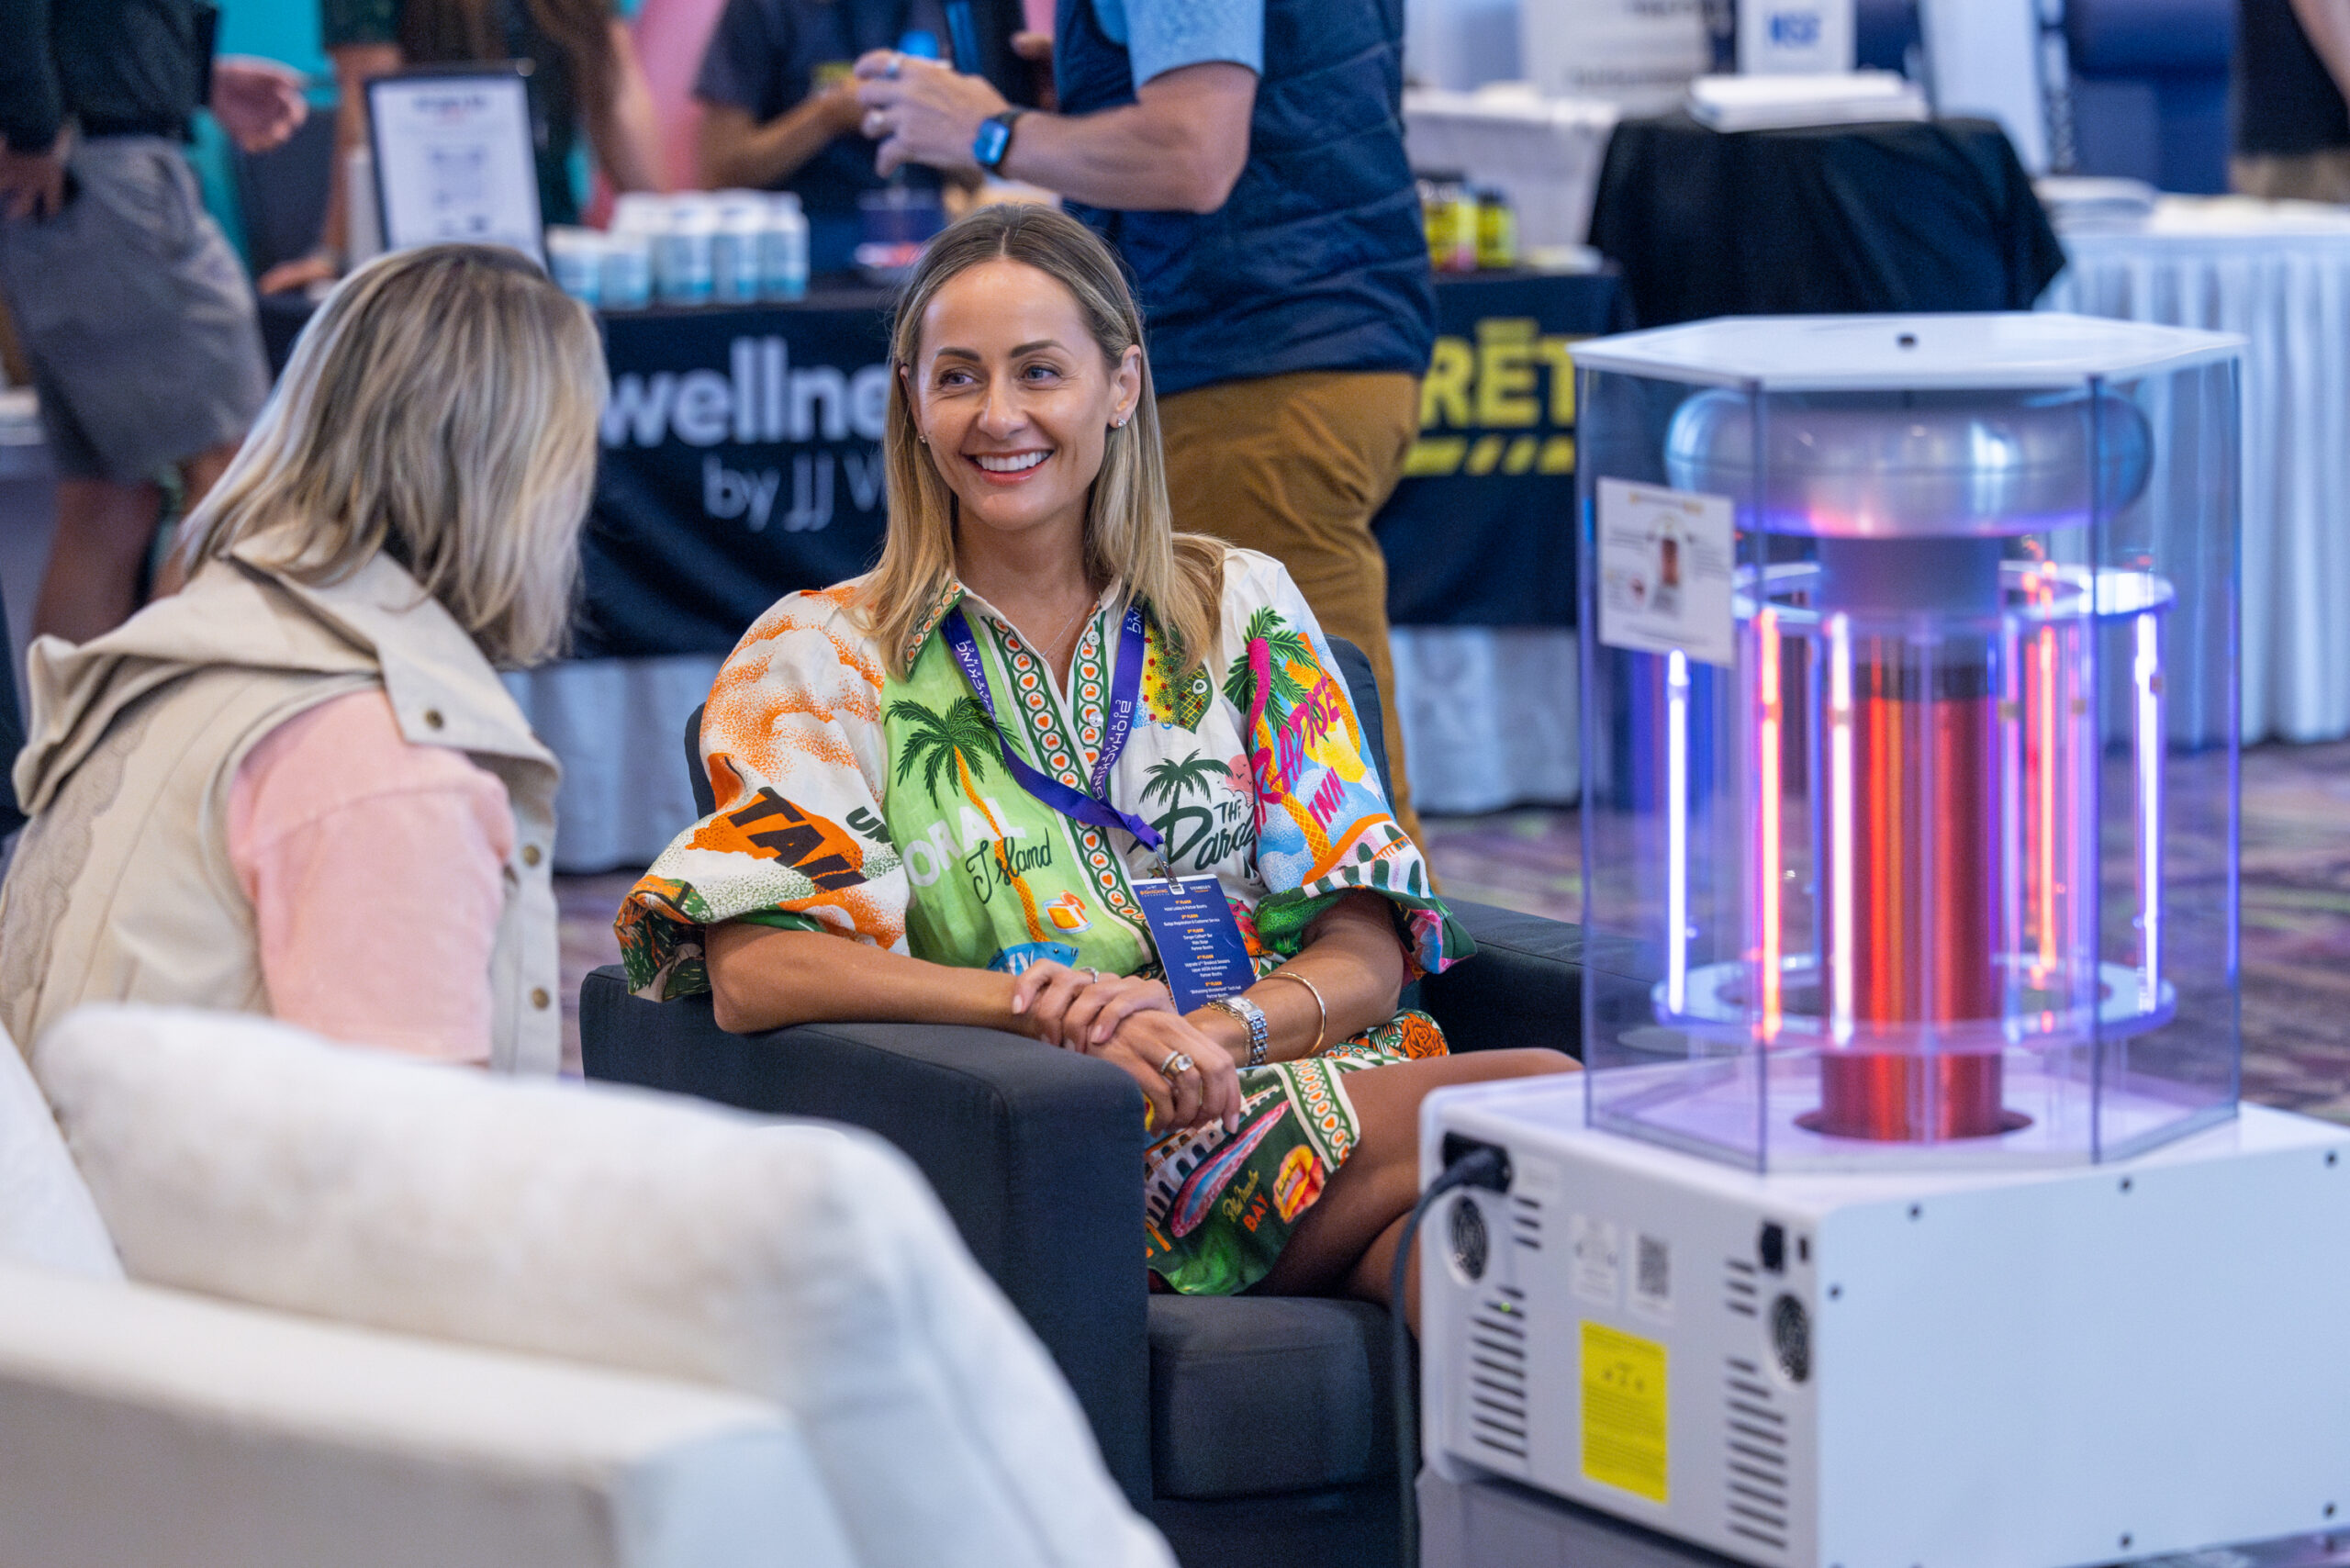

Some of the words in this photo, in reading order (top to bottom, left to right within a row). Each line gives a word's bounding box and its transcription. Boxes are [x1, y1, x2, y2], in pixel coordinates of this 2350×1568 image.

[701, 454, 780, 532] by
[784, 453, 835, 532] JJ
[1095, 700, 1132, 801] BIOHACKING
[1308, 766, 1346, 834] INN
[966, 827, 1053, 905] Island
[1243, 1193, 1269, 1232] BAY
